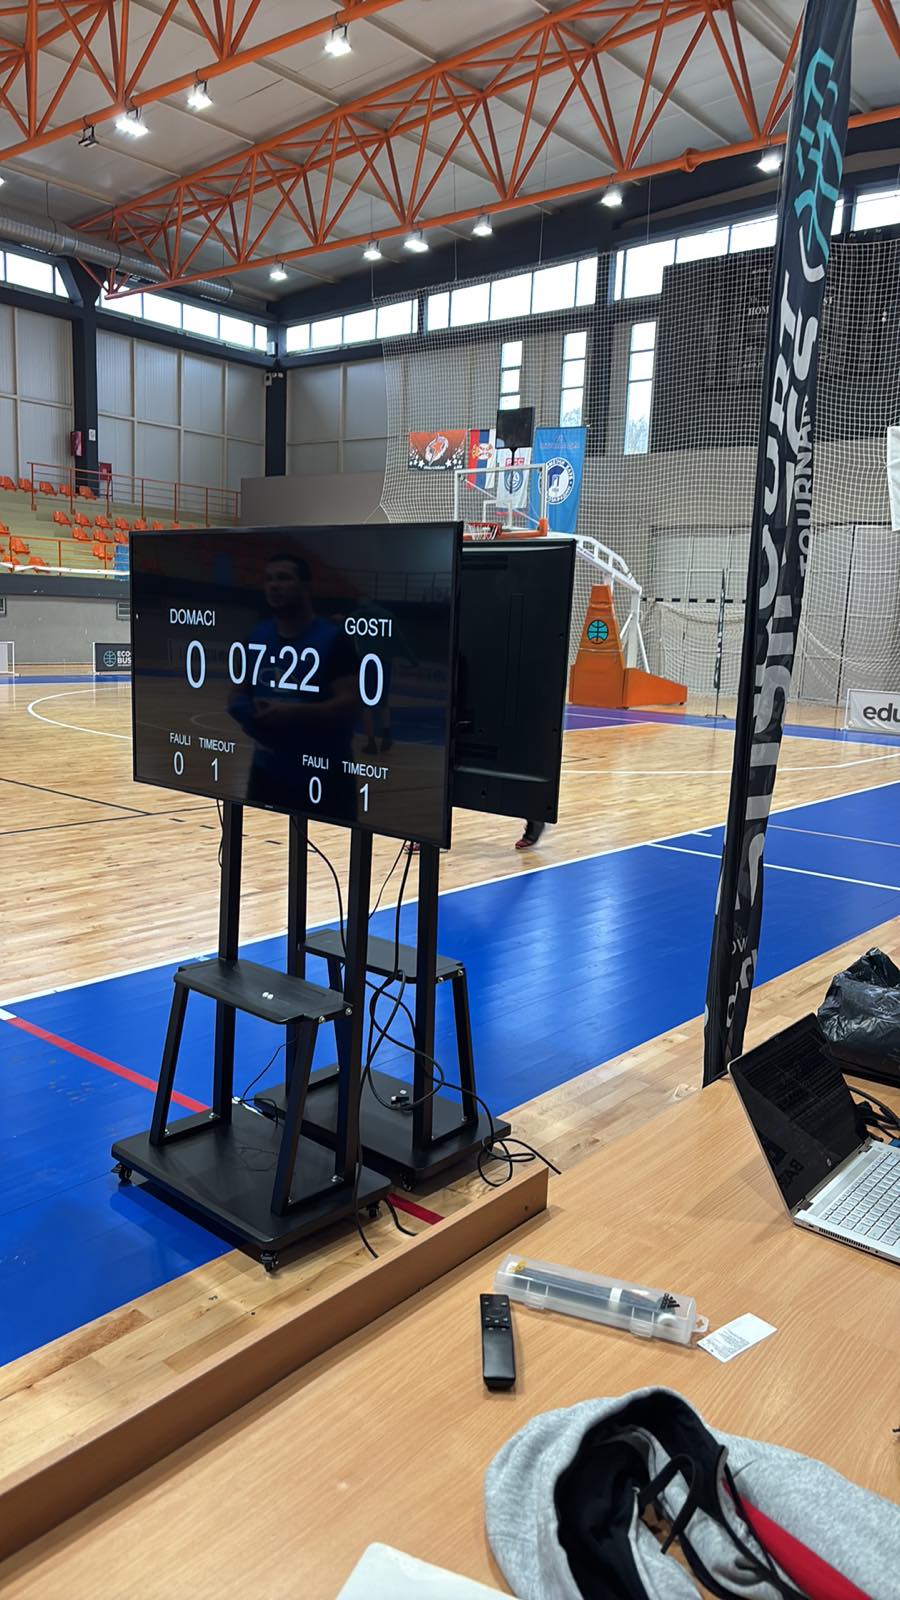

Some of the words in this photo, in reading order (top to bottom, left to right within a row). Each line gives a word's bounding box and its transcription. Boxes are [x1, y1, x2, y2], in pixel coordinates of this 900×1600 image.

[748, 305, 770, 316] HOM
[169, 608, 216, 627] DOMACI
[344, 617, 393, 638] GOSTI
[186, 639, 206, 689] 0
[228, 641, 320, 693] 07:22
[358, 653, 384, 706] 0
[169, 732, 191, 746] FAULI
[199, 736, 236, 754] TIMEOUT
[173, 751, 184, 776] 0
[211, 757, 218, 782] 1
[302, 754, 329, 770] FAULI
[341, 760, 389, 781] TIMEOUT
[308, 776, 322, 804] 0
[359, 783, 369, 812] 1
